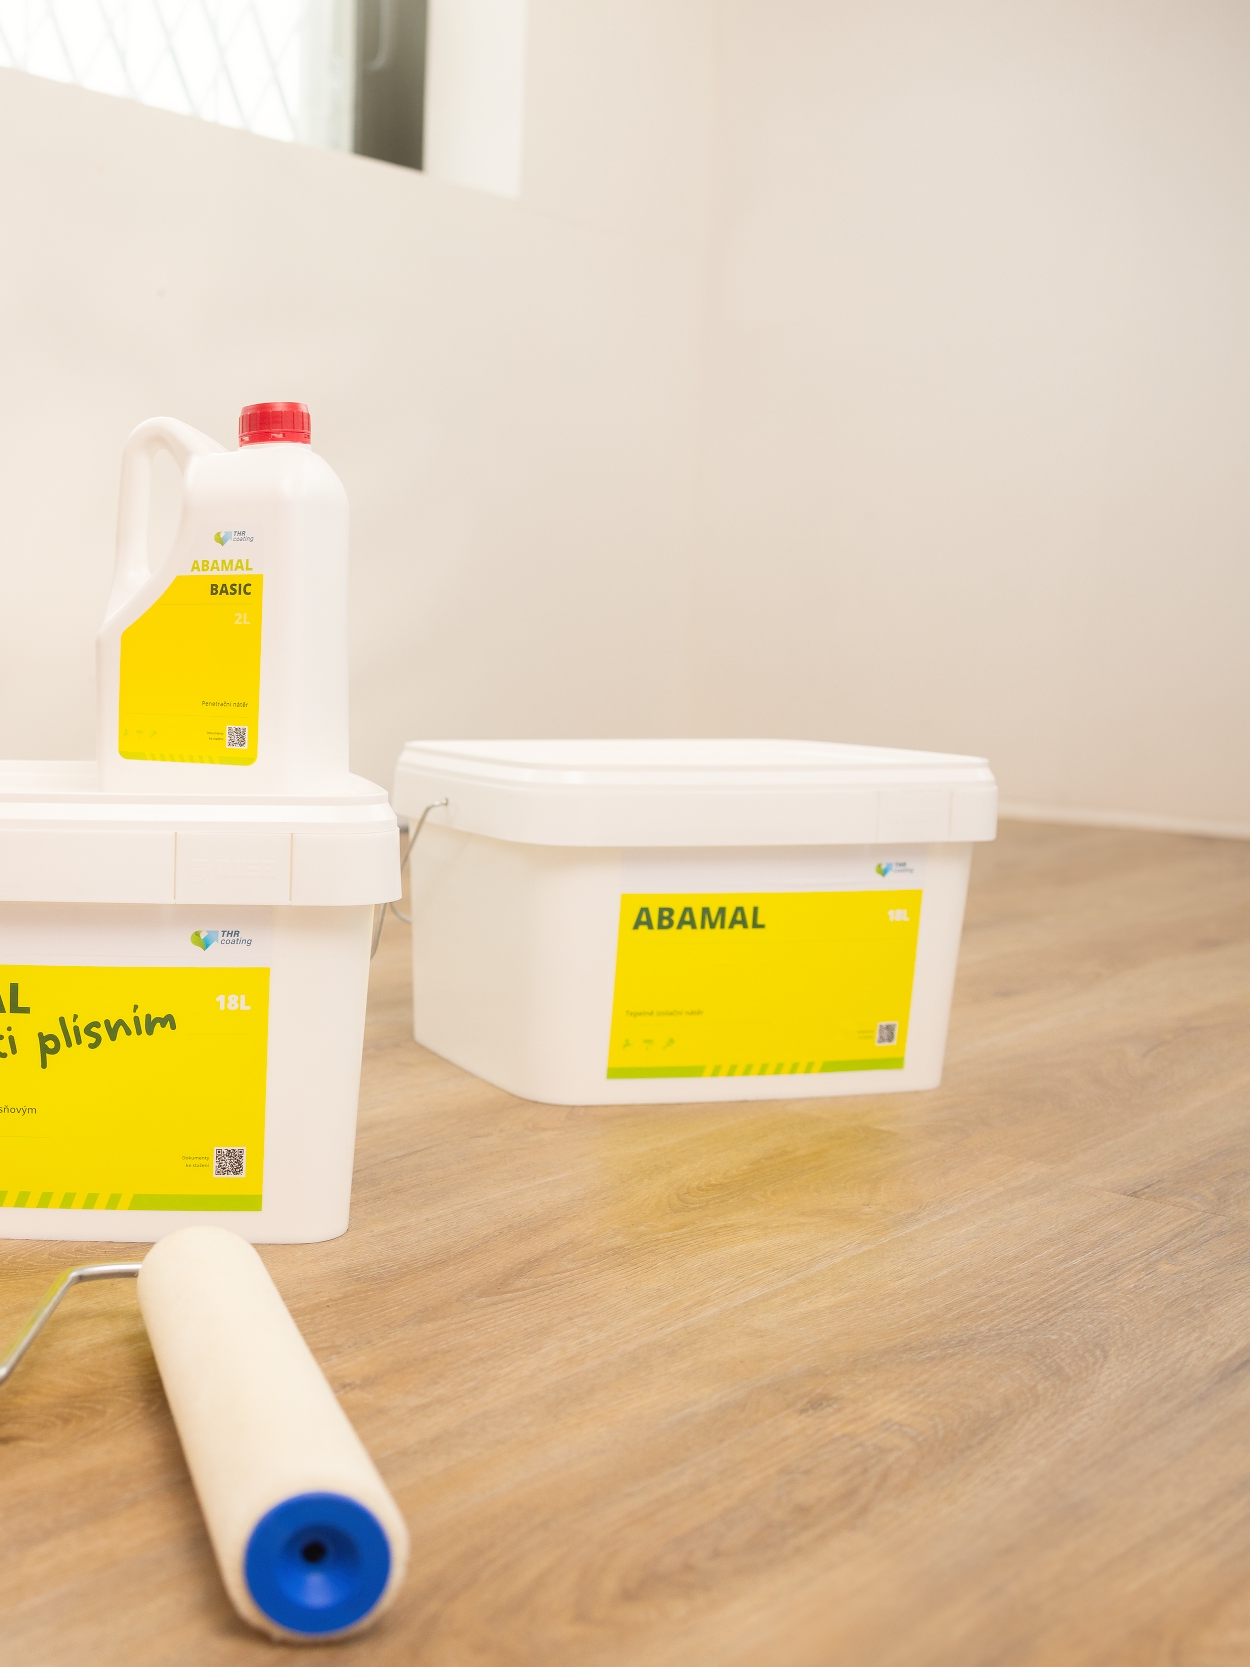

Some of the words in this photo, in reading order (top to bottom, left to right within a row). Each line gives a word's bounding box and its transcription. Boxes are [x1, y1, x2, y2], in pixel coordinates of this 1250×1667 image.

[190, 558, 253, 572] ABAMAL
[210, 583, 252, 596] BASIC
[234, 612, 251, 625] 2L
[632, 906, 766, 930] ABAMAL
[220, 930, 240, 938] THR
[220, 937, 253, 947] coating
[215, 994, 251, 1011] 18L
[37, 1004, 177, 1069] plísním
